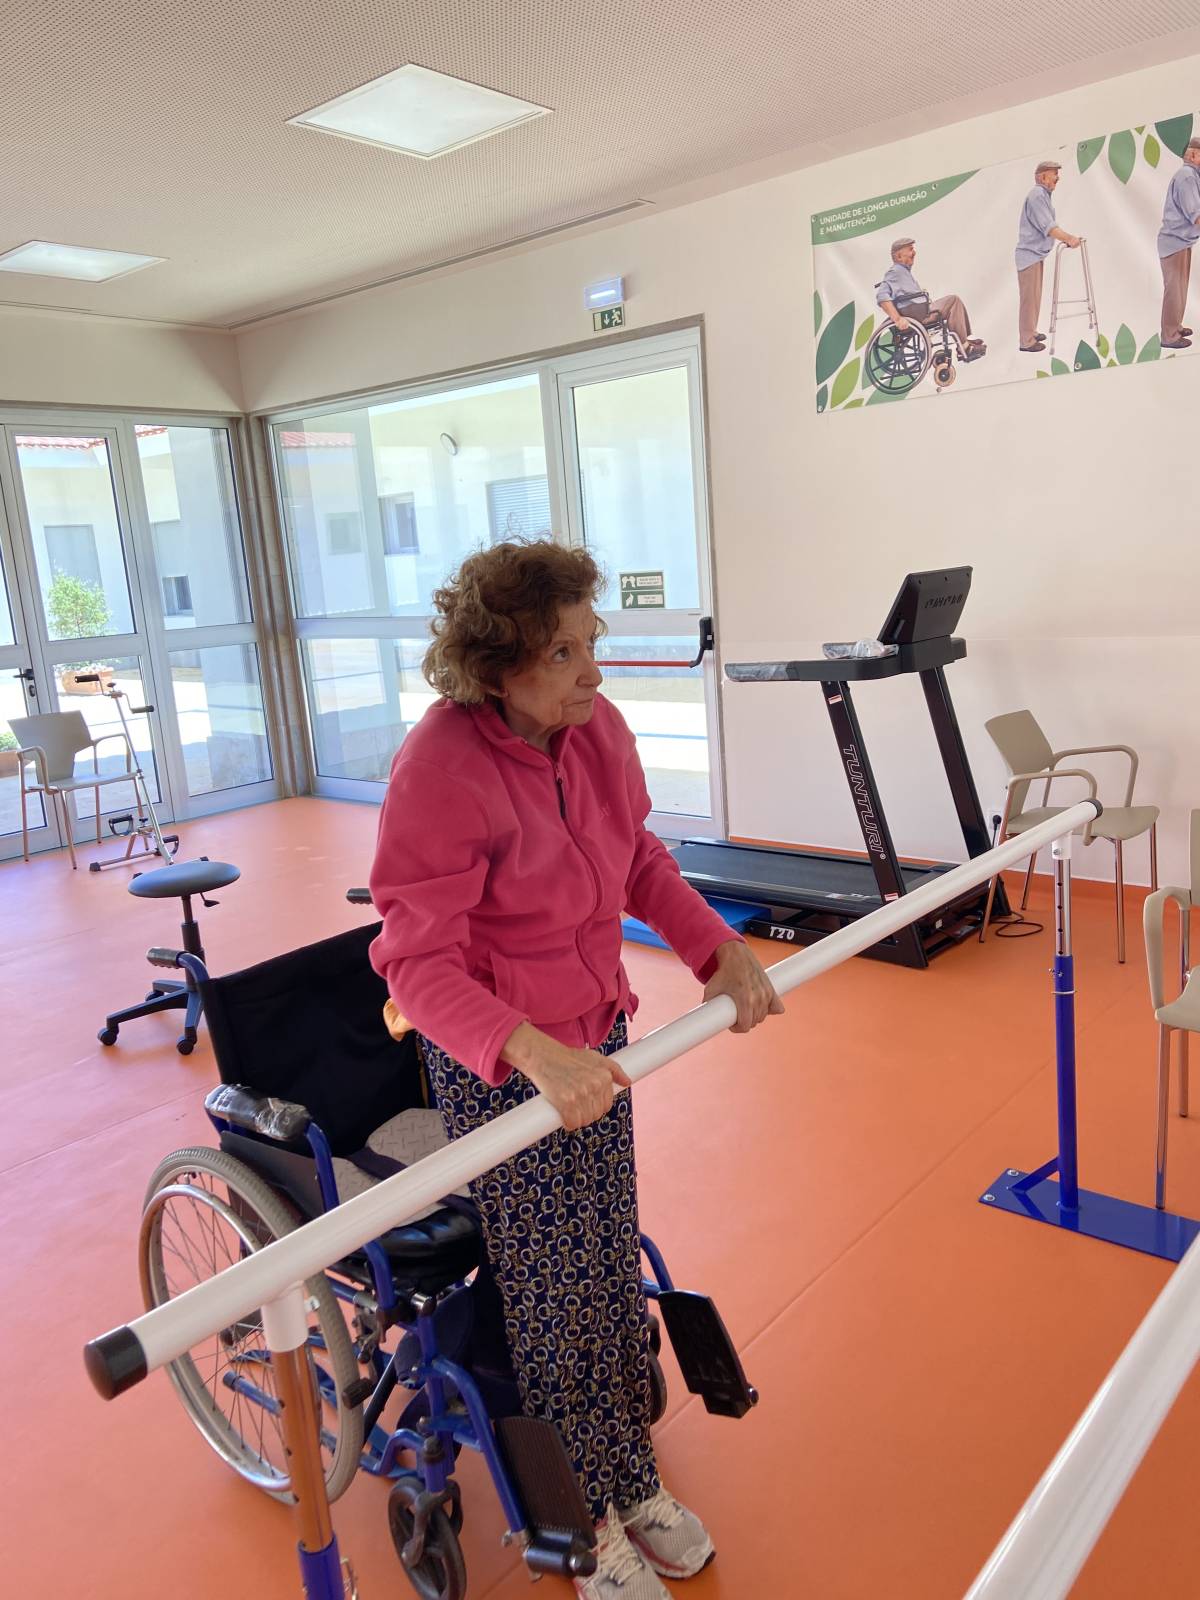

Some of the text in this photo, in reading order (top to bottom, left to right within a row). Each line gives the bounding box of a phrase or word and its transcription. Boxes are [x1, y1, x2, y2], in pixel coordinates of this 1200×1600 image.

[819, 190, 928, 225] UNIDADE DE LONGA DURAÇÃO
[825, 214, 877, 234] MANUTENÇÃO
[769, 926, 795, 940] T20
